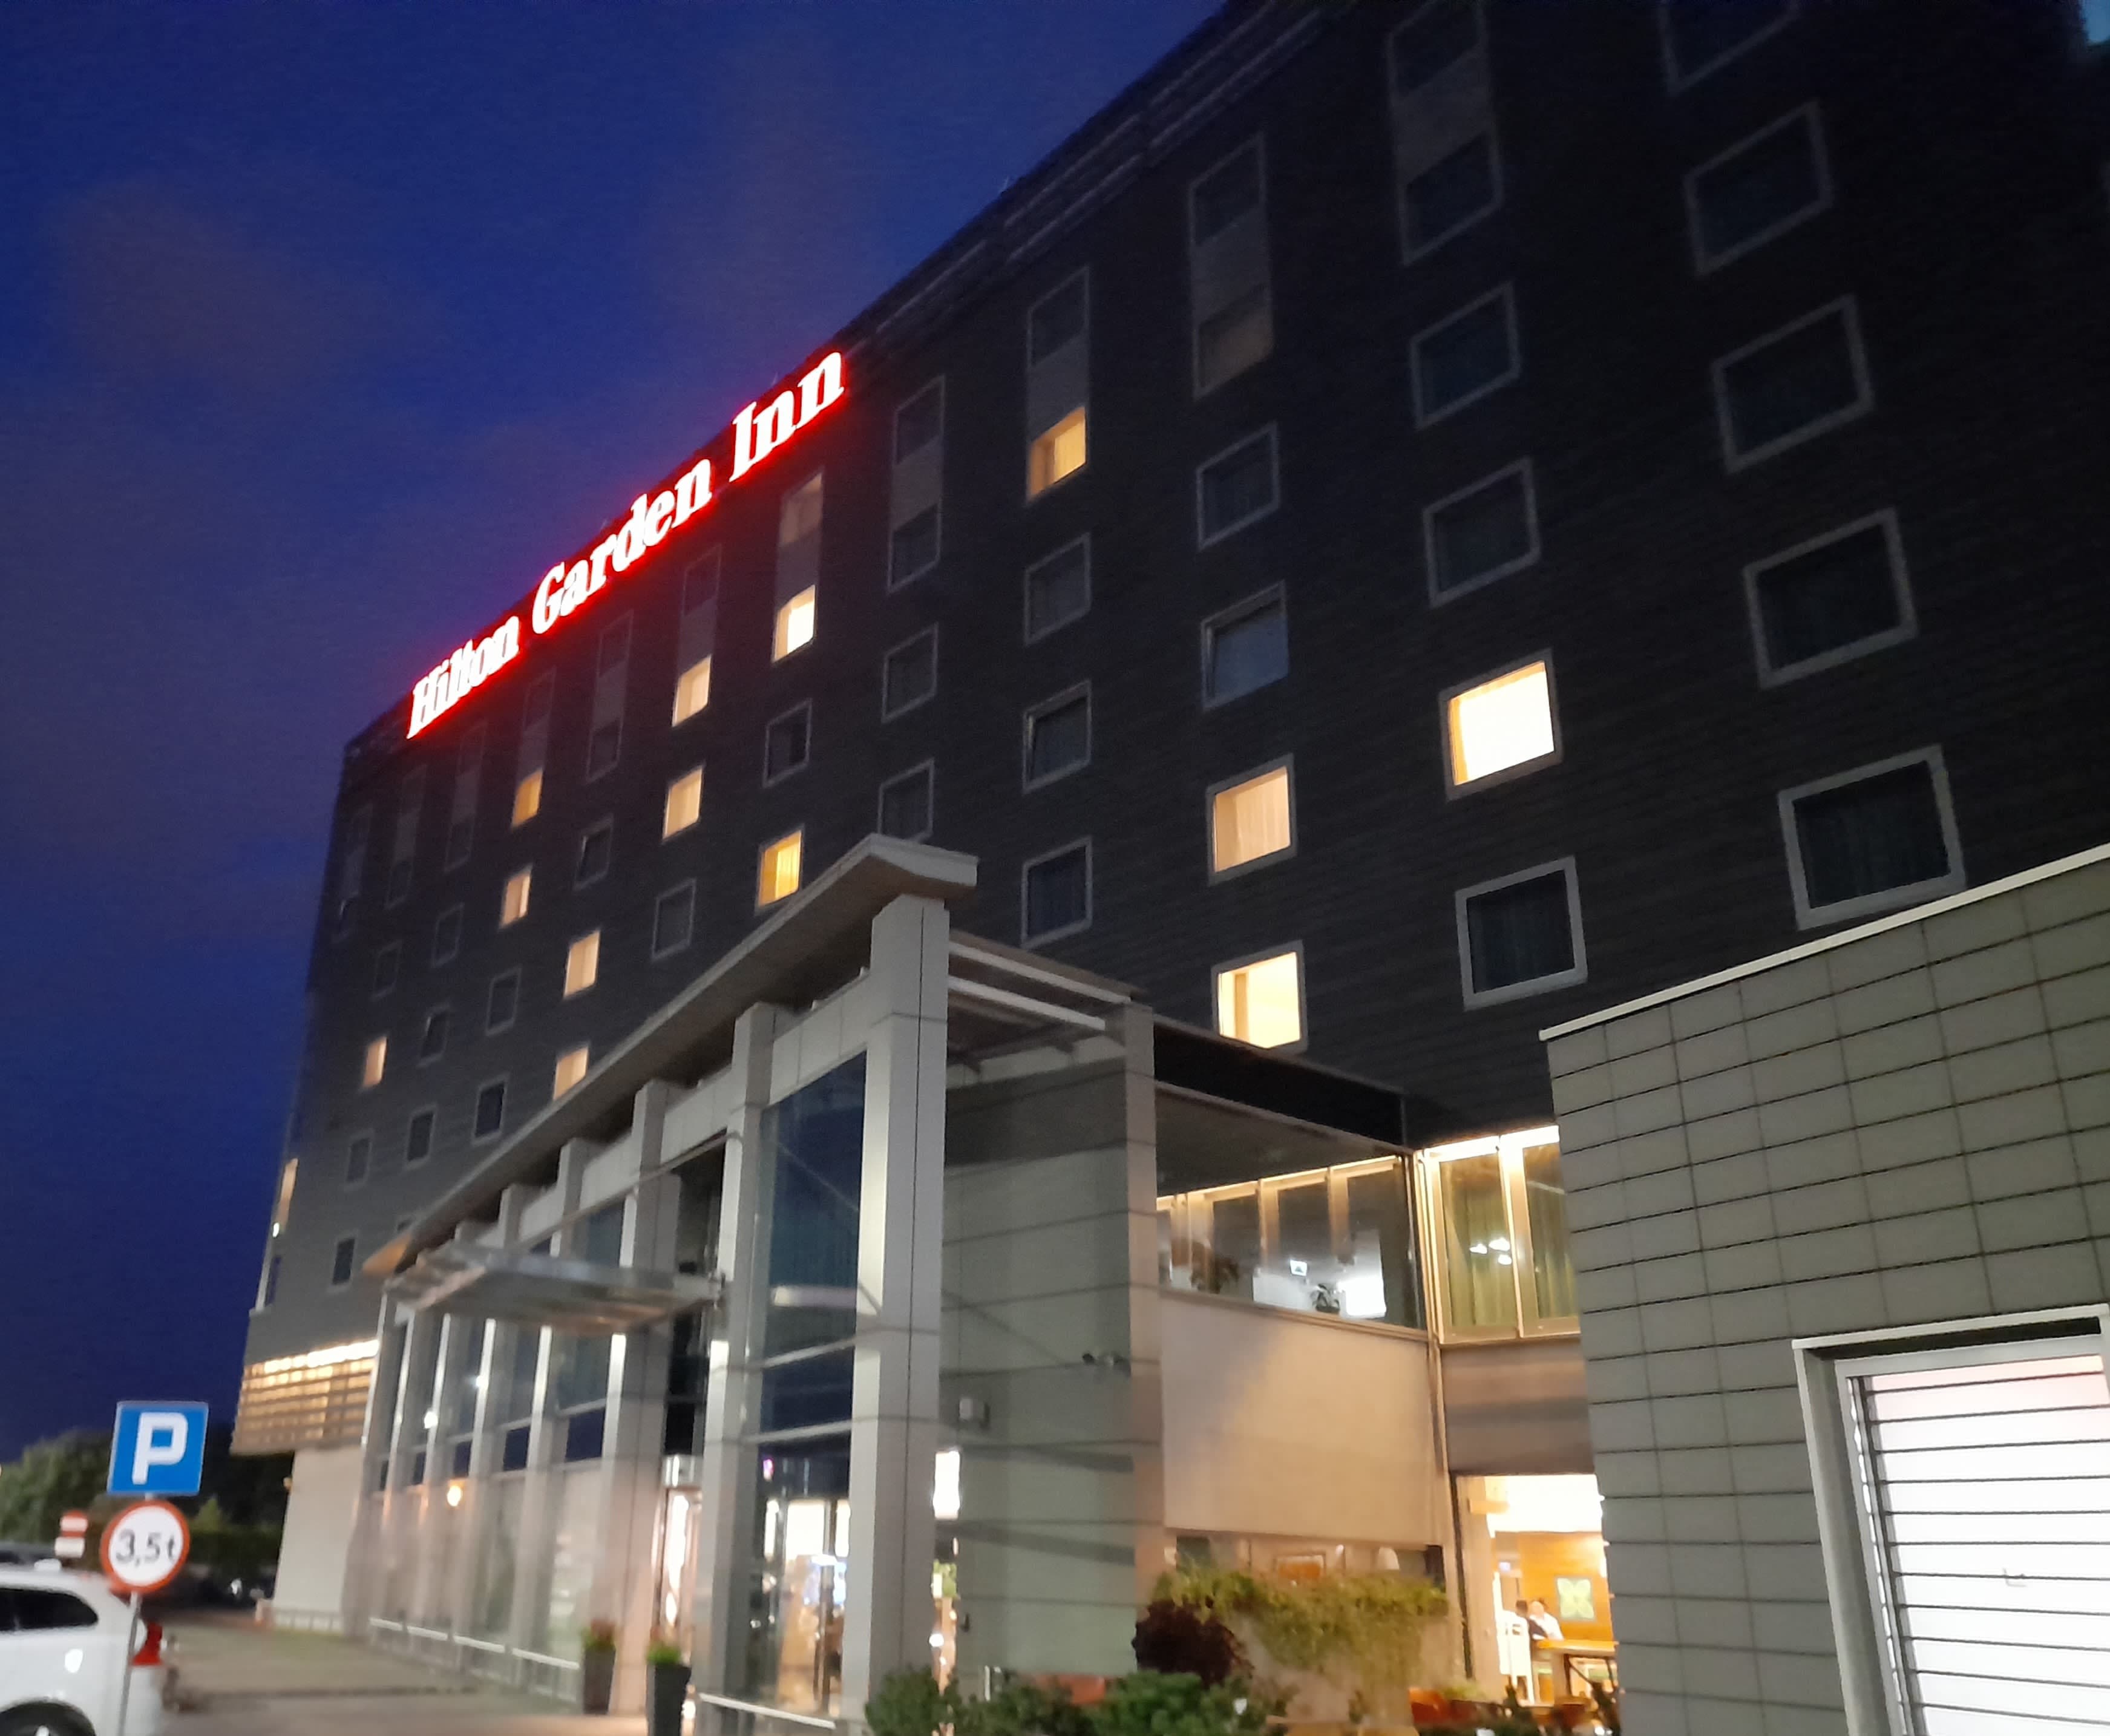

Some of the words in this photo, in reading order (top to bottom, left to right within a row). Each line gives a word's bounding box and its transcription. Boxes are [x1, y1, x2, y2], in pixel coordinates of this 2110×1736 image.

[406, 615, 519, 739] Hilton
[531, 458, 712, 634] Garden
[729, 352, 844, 482] Inn
[132, 1412, 188, 1484] P
